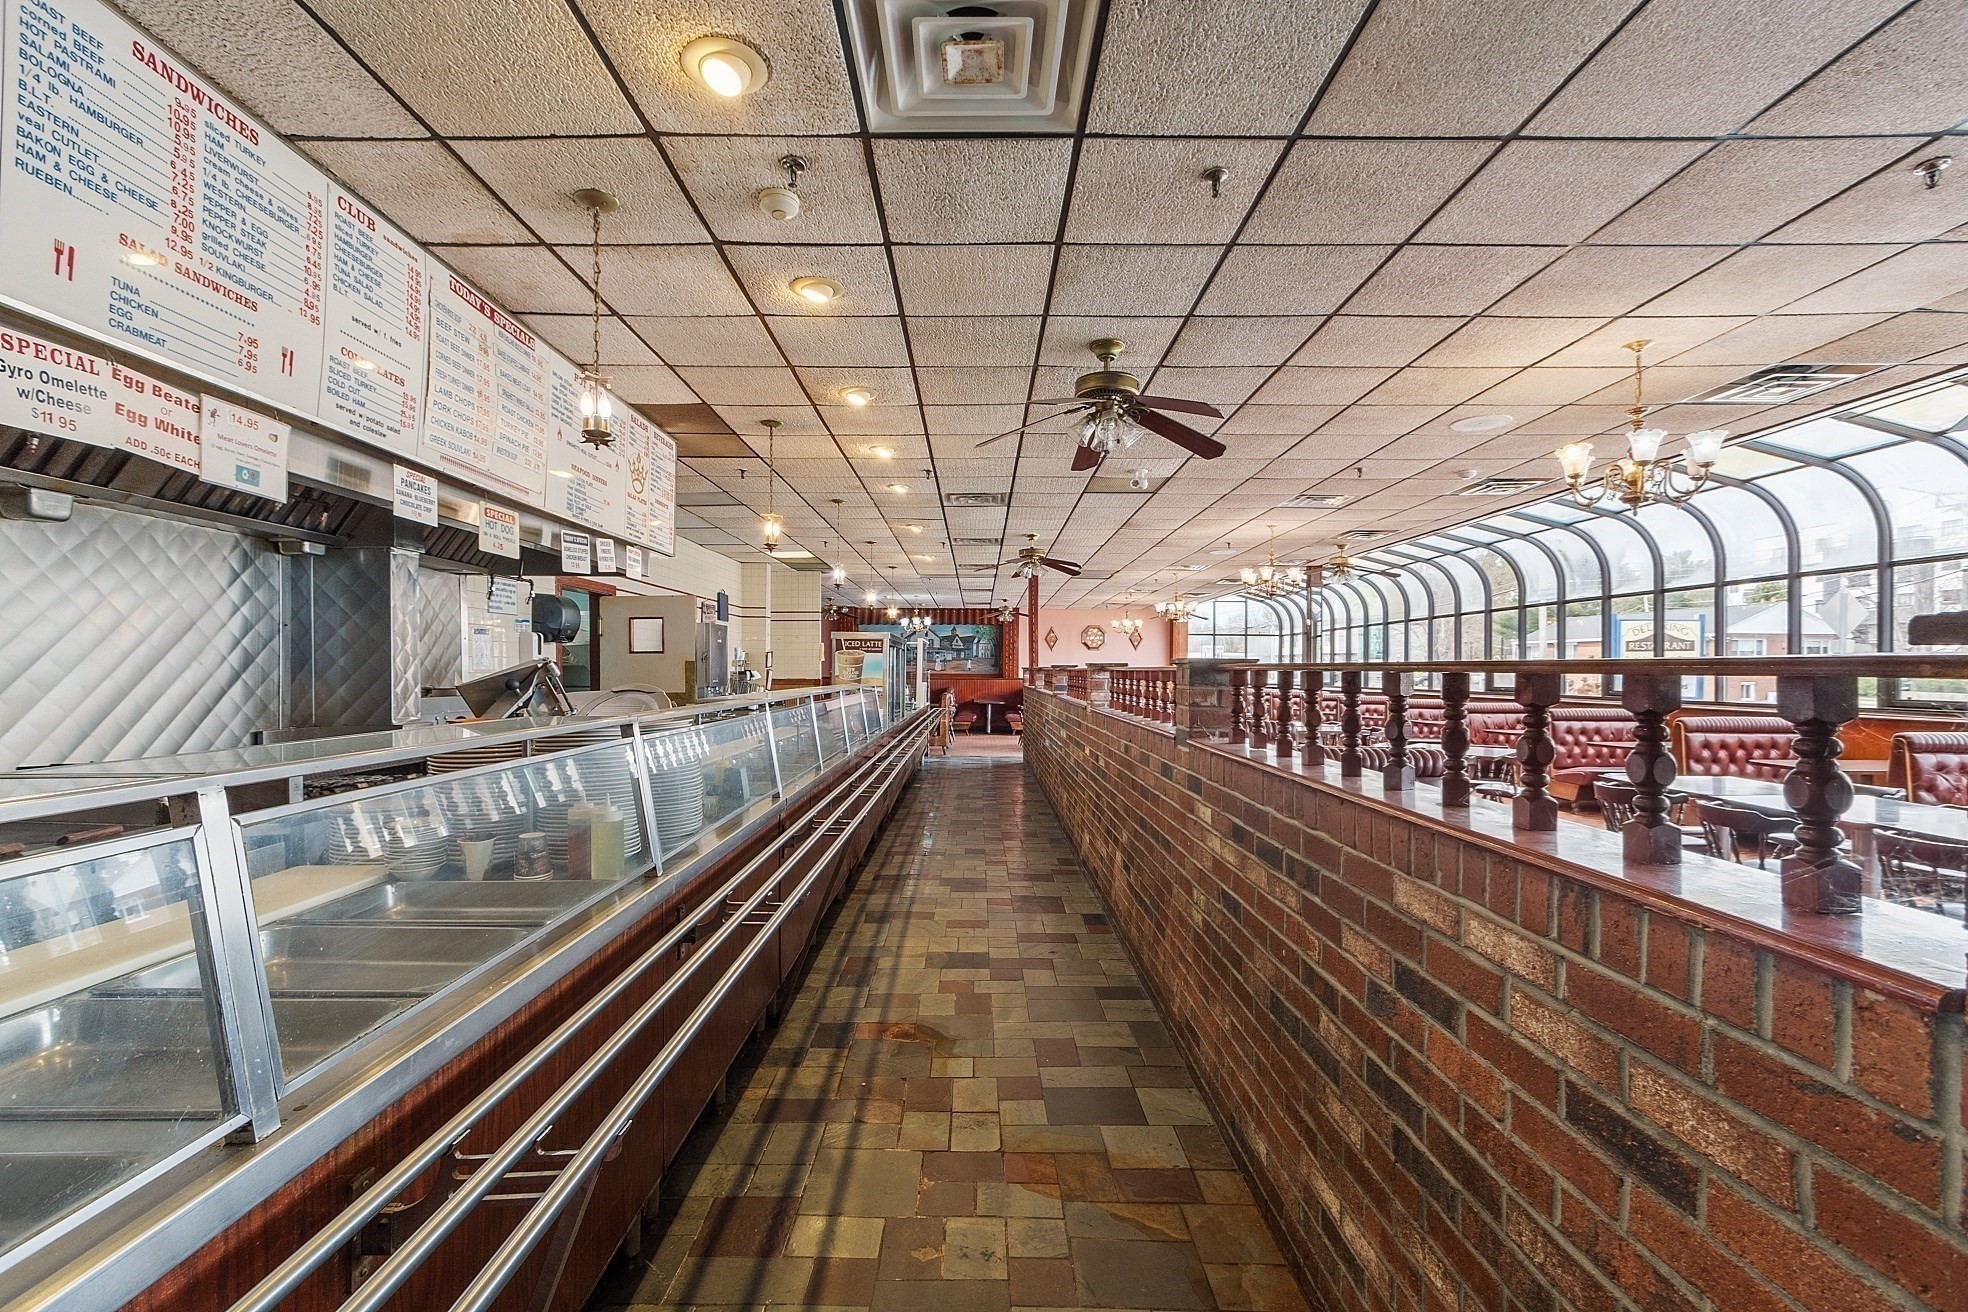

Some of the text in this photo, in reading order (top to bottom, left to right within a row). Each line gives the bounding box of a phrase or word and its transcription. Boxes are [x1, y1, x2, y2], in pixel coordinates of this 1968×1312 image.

[19, 16, 116, 88] HOT PASTRAMI
[19, 33, 70, 73] SALAMI
[20, 5, 196, 131] corned BEEF 10.95
[19, 47, 84, 97] BOLOGNA
[72, 23, 104, 50] BEEF
[175, 97, 196, 118] 9.95
[132, 40, 259, 146] SANDWICHES
[18, 78, 195, 194] B.L.T. 7.25
[19, 64, 195, 181] 1/4 lb. HAMBURGER 6.45
[17, 93, 195, 207] EASTERN 6.75
[204, 131, 224, 151] HAM
[204, 120, 266, 167] sliced TURKEY
[16, 125, 195, 233] BAKON EGG & CHEESE 7.00
[17, 111, 194, 219] veal CUTLET 8.25
[204, 143, 259, 186] LIVERWURST
[15, 140, 193, 244] HAM & CHEESE 9.95
[203, 156, 231, 178] cream
[234, 177, 264, 200] cheese
[277, 205, 299, 223] olives
[203, 180, 246, 214] WESTERN
[15, 157, 193, 260] RUEBEN 12.95
[203, 193, 237, 220] PEPPER
[251, 223, 269, 240] EGG
[235, 188, 300, 236] CHEESEBURGER
[202, 205, 237, 232] PEPPER
[240, 228, 268, 250] STEAK
[202, 217, 264, 259] KNOCKWURST
[334, 211, 373, 242] ROAST BEEF
[334, 223, 379, 257] sliced TURKEY
[337, 195, 418, 263] CLUB sandwiches
[201, 232, 229, 251] grilled
[232, 248, 266, 272] CHEESE
[201, 242, 246, 273] SOUVLAKI
[334, 232, 373, 262] HAMBURGER
[334, 243, 384, 280] CHEESEBURGER
[174, 262, 258, 312] SANDWICHES
[199, 257, 274, 302] 1/2 KINGBURGER
[334, 253, 382, 288] HAM CHEESE
[334, 263, 374, 293] TUNA SALAD
[333, 273, 383, 309] CHICKEN SALAD
[109, 303, 133, 321] EGG
[109, 290, 258, 362] CHICKEN 7.95
[110, 276, 259, 349] TUNA 7.95
[351, 315, 372, 331] served
[450, 280, 491, 316] TODAY'S
[493, 312, 535, 348] SPECIALS
[108, 317, 167, 348] CRABMEAT
[435, 317, 452, 332] BEEF
[454, 328, 470, 345] STEIN
[0, 332, 100, 376] SPECIAL
[329, 355, 369, 379] ROAST BEEF
[39, 370, 108, 401] Omelette
[111, 367, 145, 394] Egg
[327, 376, 361, 396] COLD CUT
[328, 365, 377, 393] SLICED TURKEY
[16, 386, 92, 415] w/Cheese
[160, 407, 173, 417] or
[326, 386, 366, 408] BOILED HAM
[335, 402, 356, 416] served
[432, 400, 474, 425] PORK CHOPS
[434, 384, 475, 411] LAMB CHOPS
[114, 402, 148, 428] Egg
[231, 413, 259, 431] 14.95
[349, 419, 387, 438] and coleslaw
[431, 416, 473, 440] CHICKEN KABOB
[125, 436, 148, 450] ADD
[174, 453, 200, 469] EACH
[217, 433, 234, 446] Meat
[430, 434, 446, 447] GREEK
[400, 478, 431, 495] PANCAKES
[406, 471, 426, 483] SPECIAL
[485, 520, 513, 535] HOT DOG
[486, 508, 515, 524] SPECIAL
